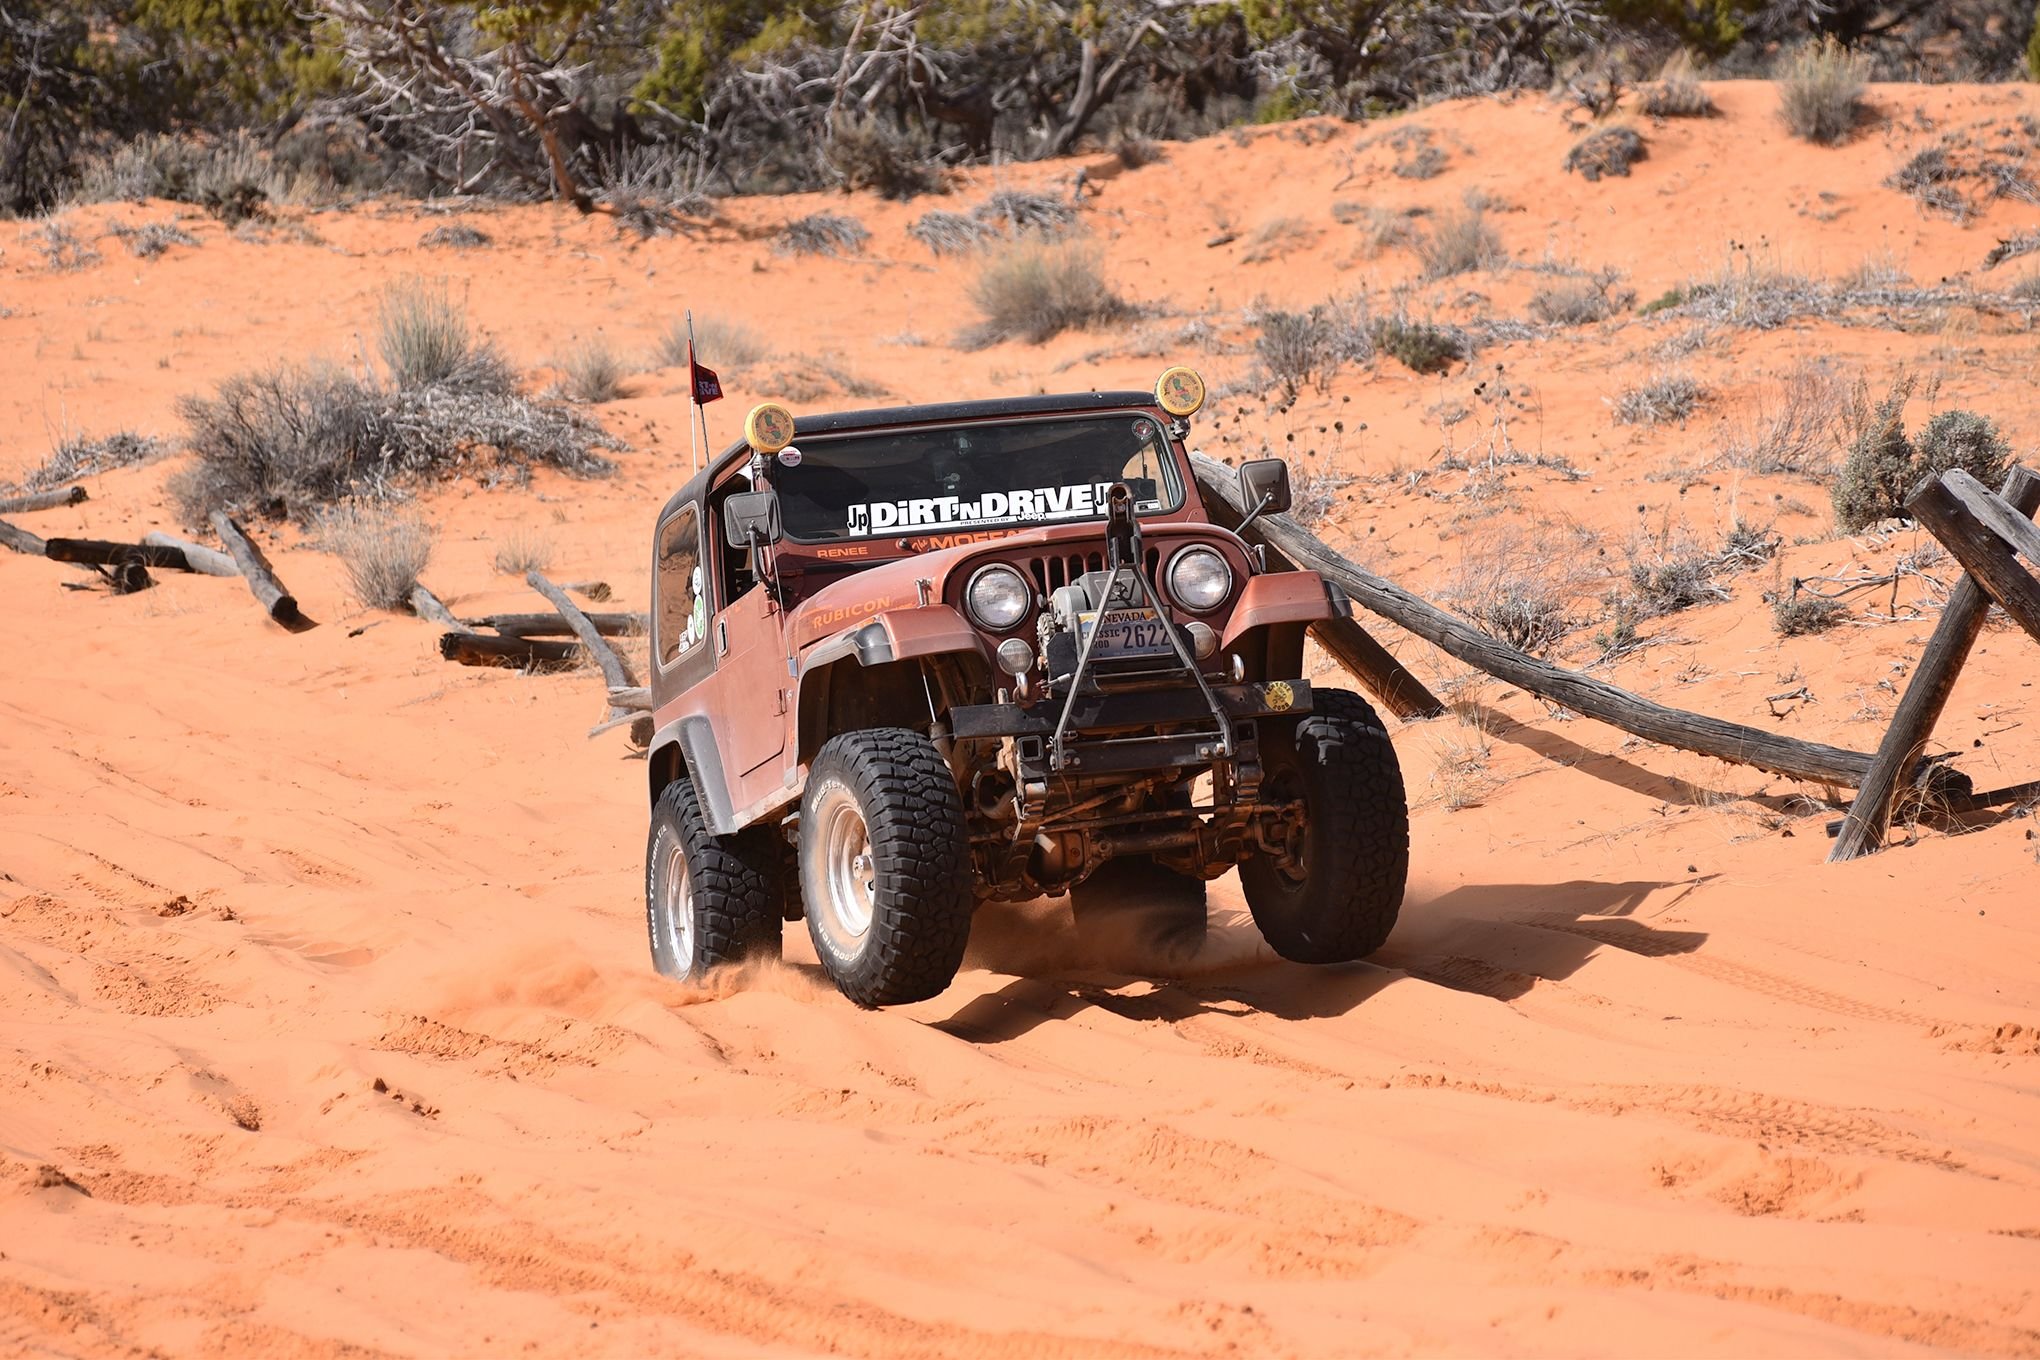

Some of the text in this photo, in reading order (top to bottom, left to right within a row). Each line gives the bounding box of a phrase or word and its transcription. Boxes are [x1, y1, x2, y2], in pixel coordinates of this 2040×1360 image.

[1017, 511, 1045, 522] Jeep
[816, 546, 868, 558] RENEE
[812, 596, 891, 629] RUBICON
[1103, 611, 1146, 623] NEVADA
[1081, 628, 1120, 640] CLSSIC
[1121, 623, 1171, 649] 2622
